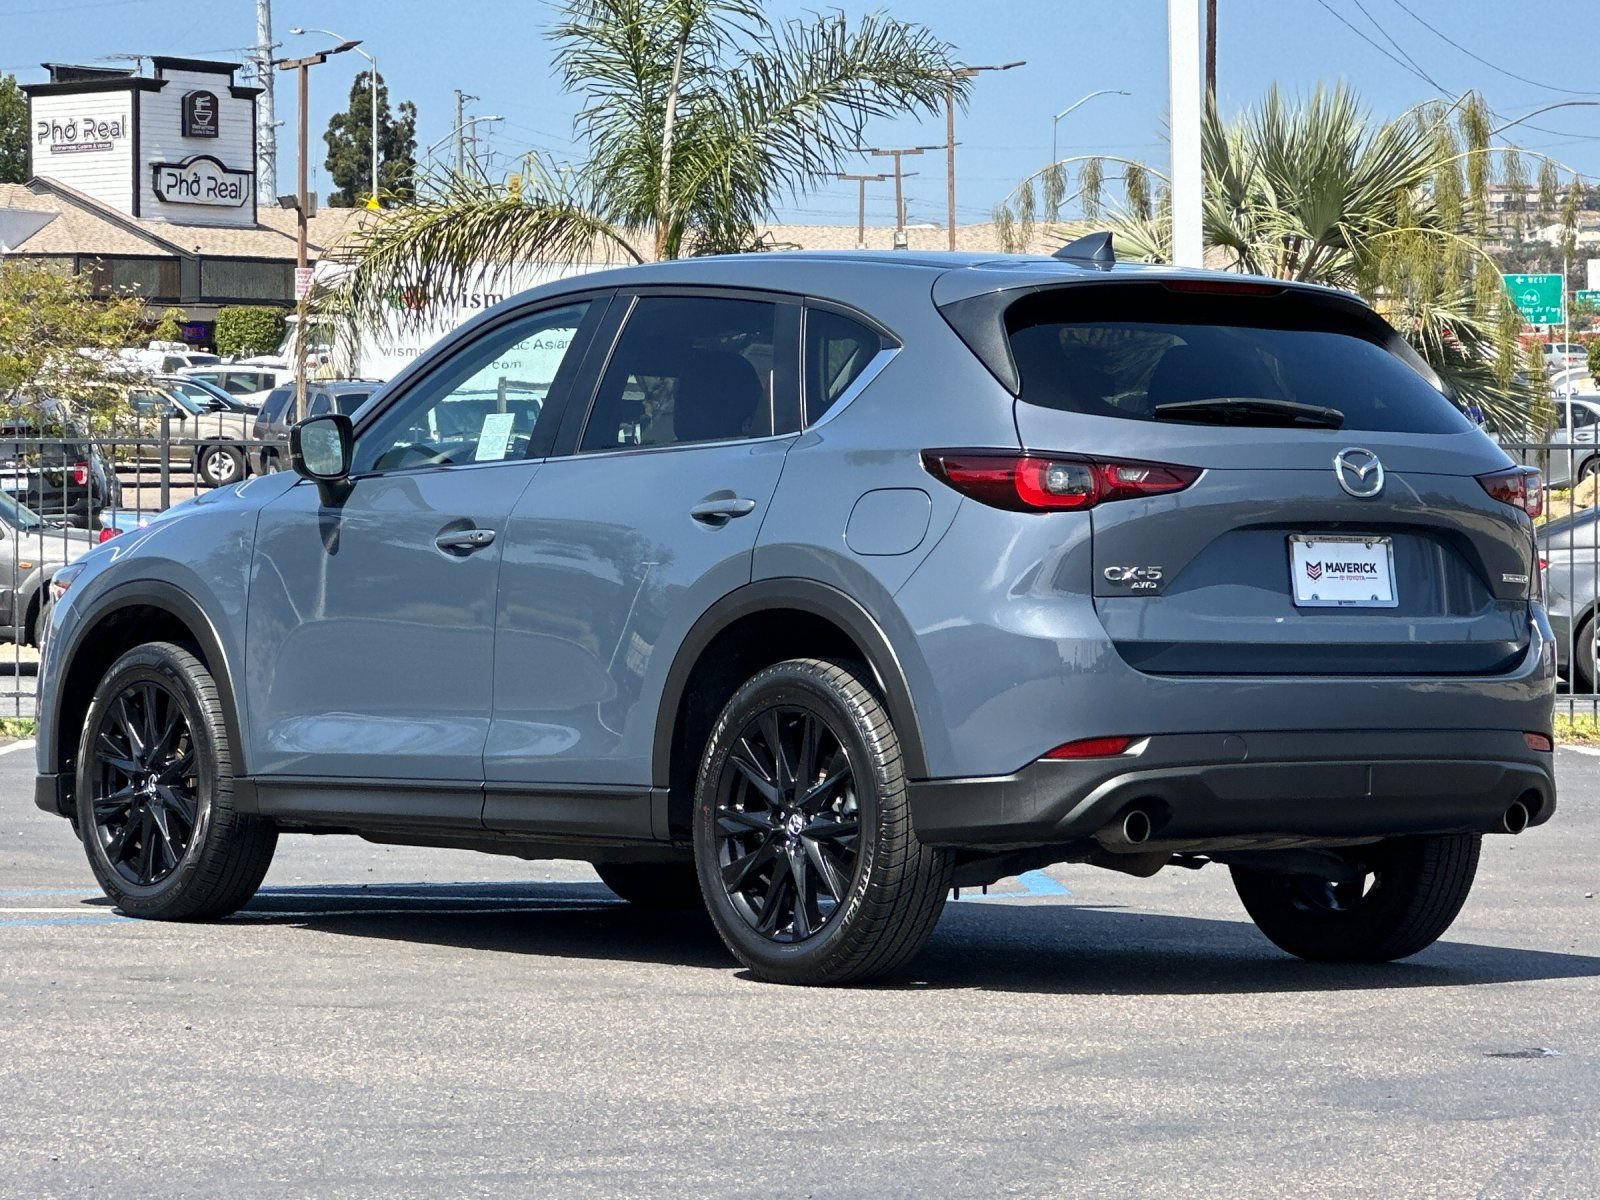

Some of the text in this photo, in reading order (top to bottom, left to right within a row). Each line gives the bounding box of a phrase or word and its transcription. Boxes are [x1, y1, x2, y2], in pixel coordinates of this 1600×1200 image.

[83, 115, 126, 139] Real
[207, 176, 242, 200] Real
[440, 286, 504, 309] Wism
[381, 345, 425, 357] wism
[1104, 566, 1163, 580] CX-5
[1325, 562, 1377, 574] MAVERICK
[1131, 581, 1158, 589] AWD
